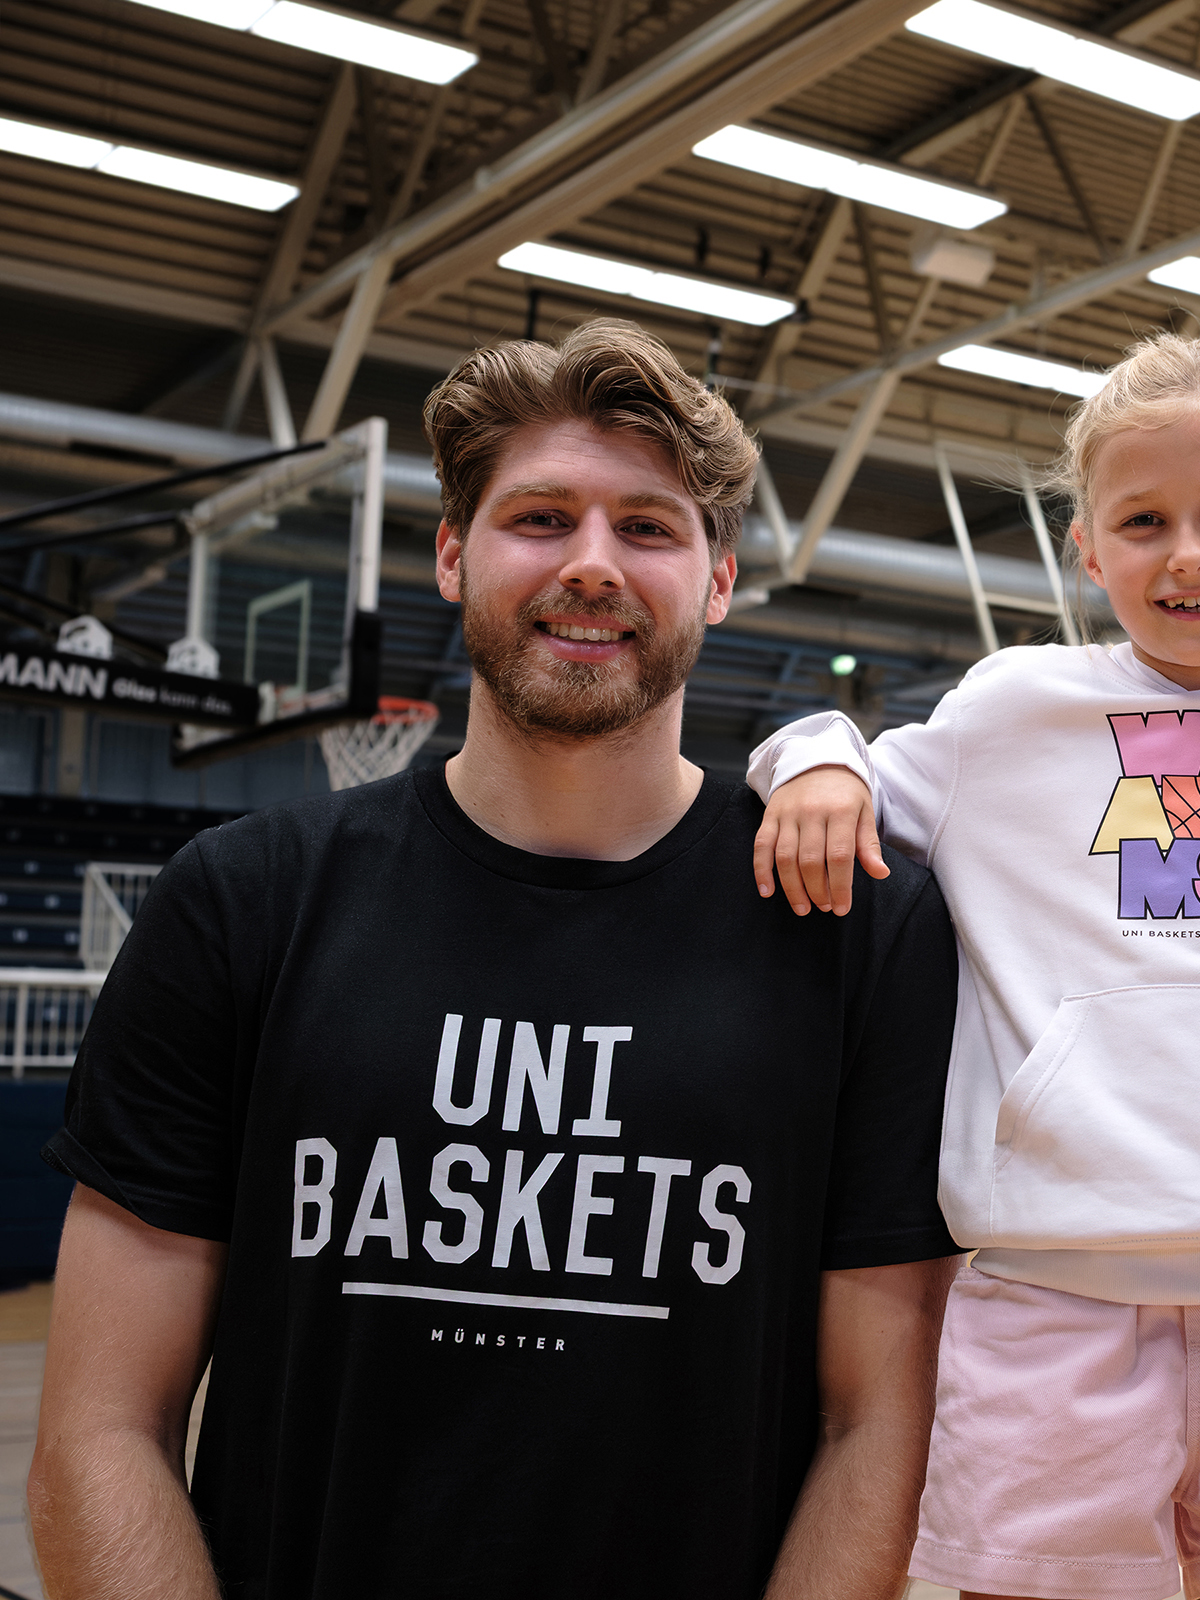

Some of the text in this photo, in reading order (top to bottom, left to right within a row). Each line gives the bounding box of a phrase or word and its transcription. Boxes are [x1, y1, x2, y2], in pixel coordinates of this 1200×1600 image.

[1122, 929, 1144, 938] UNI
[432, 1013, 633, 1137] UNI
[291, 1137, 752, 1285] BASKETS
[430, 1328, 565, 1351] MÜNSTER
